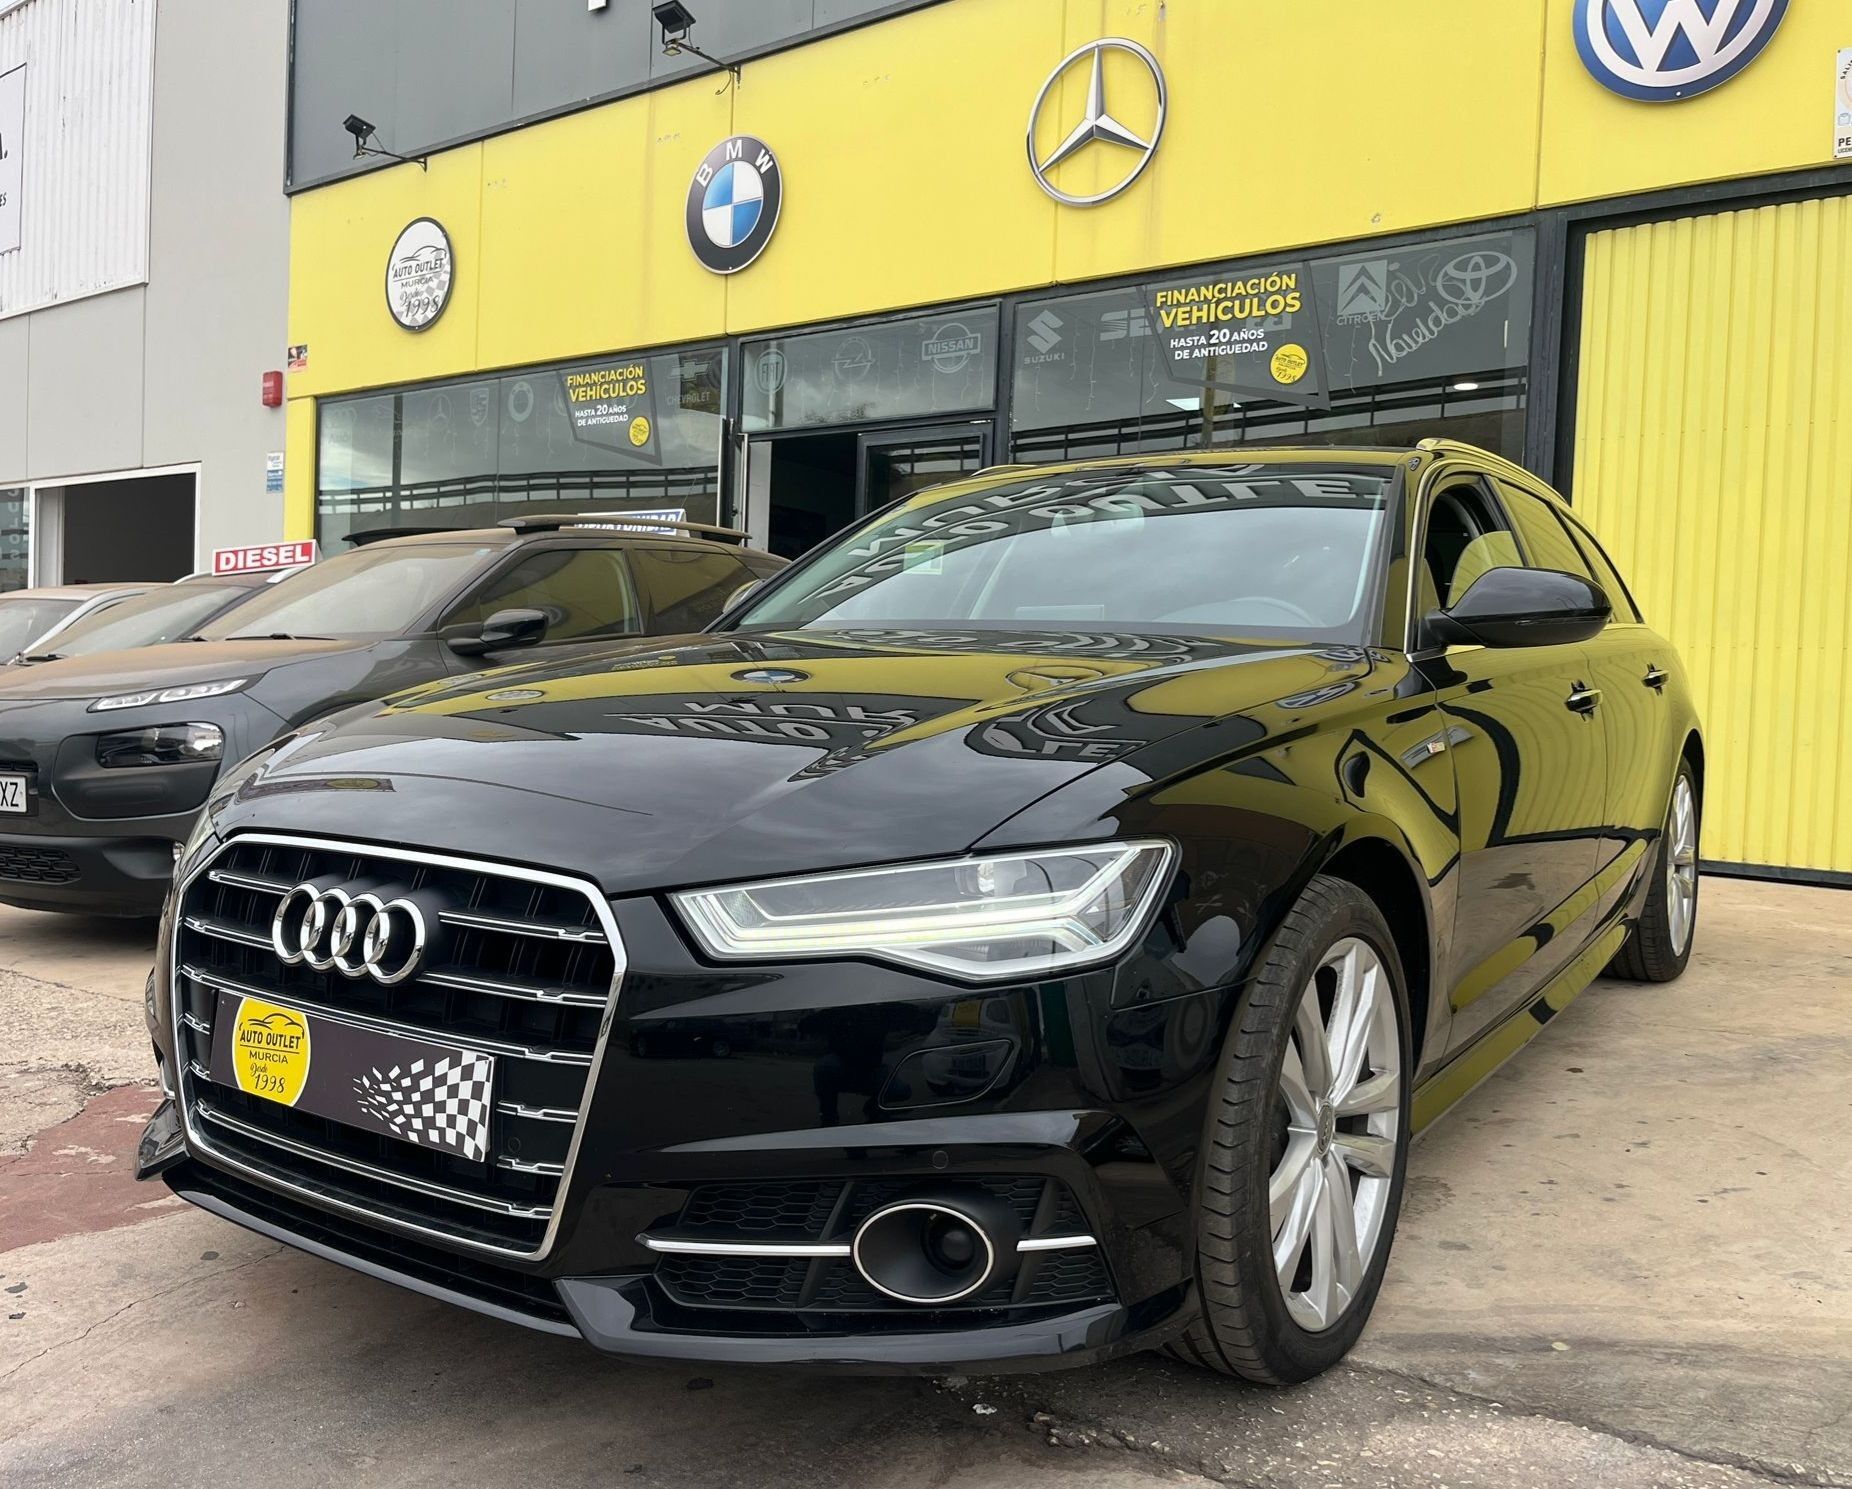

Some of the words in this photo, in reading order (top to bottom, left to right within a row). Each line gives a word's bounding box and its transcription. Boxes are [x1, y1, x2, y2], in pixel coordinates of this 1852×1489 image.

[696, 140, 774, 187] BMW
[393, 264, 412, 279] AUTO
[414, 258, 444, 274] OUTLET
[401, 276, 434, 289] MURCIA
[1156, 271, 1297, 308] FINANCIACIÓN
[405, 295, 440, 317] 1998
[1159, 291, 1302, 328] VEHÍCULOS
[927, 337, 974, 354] NISSAN
[1170, 336, 1207, 349] HASTA
[1209, 329, 1231, 344] 20
[1231, 328, 1265, 342] AÑOS
[1024, 352, 1065, 365] SUZUKI
[1175, 350, 1190, 360] DE
[1192, 341, 1268, 358] ANTIGUEDAD
[567, 366, 643, 386] FINANCIACIÓN
[570, 381, 646, 402] VEHÍCULOS
[666, 391, 711, 405] CHEVROLET
[575, 409, 596, 418] HASTA
[597, 404, 608, 415] 20
[609, 404, 627, 413] AÑOS
[587, 414, 629, 426] ANTIGUEDAD
[219, 545, 310, 571] DIESEL
[240, 1029, 264, 1045] AUTO
[265, 1032, 301, 1050] OUTLET
[249, 1050, 289, 1065] MURCIA
[254, 1073, 286, 1094] 1998
